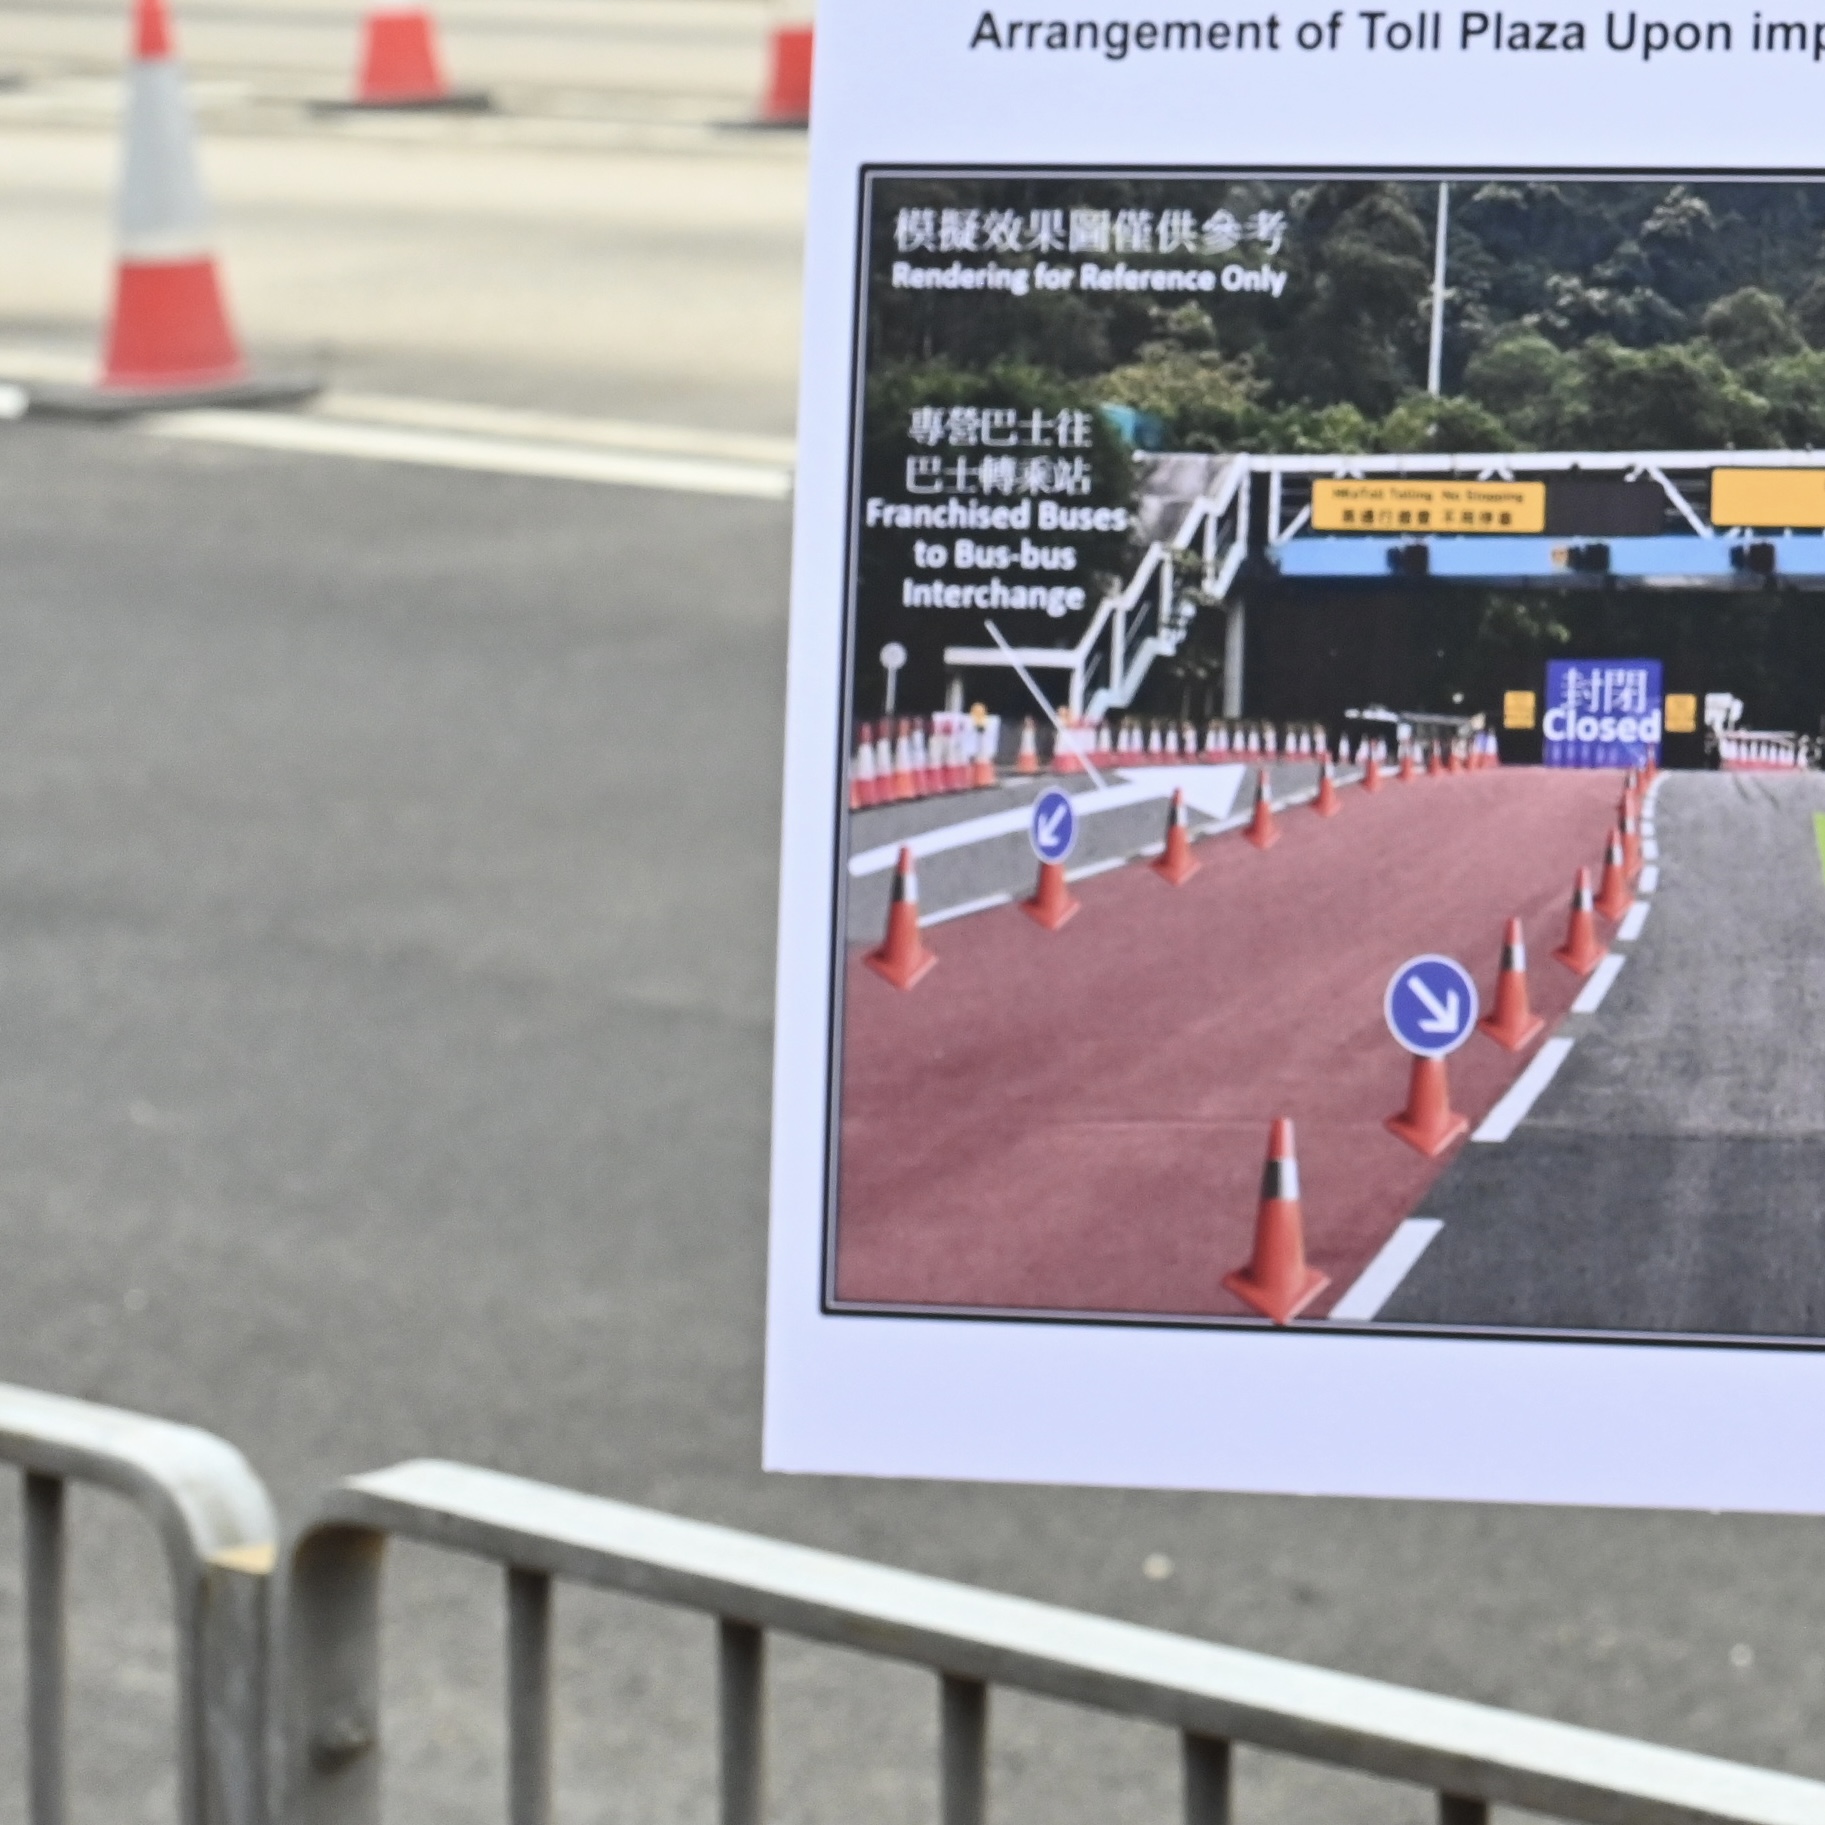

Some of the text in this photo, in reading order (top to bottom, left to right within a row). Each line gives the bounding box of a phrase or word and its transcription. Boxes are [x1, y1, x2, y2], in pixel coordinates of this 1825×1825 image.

[970, 9, 1280, 61] Arrangement
[1296, 9, 1344, 52] of
[1358, 10, 1441, 52] Toll
[1460, 10, 1586, 52] Plaza
[1606, 11, 1732, 62] Upon
[894, 207, 1287, 256] 模擬效果圖僅供參考
[891, 261, 1288, 297] Rendering for Reference Only
[908, 406, 1093, 448] 專營巴士往
[905, 455, 1092, 495] 巴士轉乘站
[865, 497, 1130, 531] Franchised Buses
[914, 538, 1077, 571] to Bus-bus
[903, 578, 1086, 617] Interchange
[1560, 666, 1648, 714] 封閉
[1542, 706, 1662, 744] Closed
